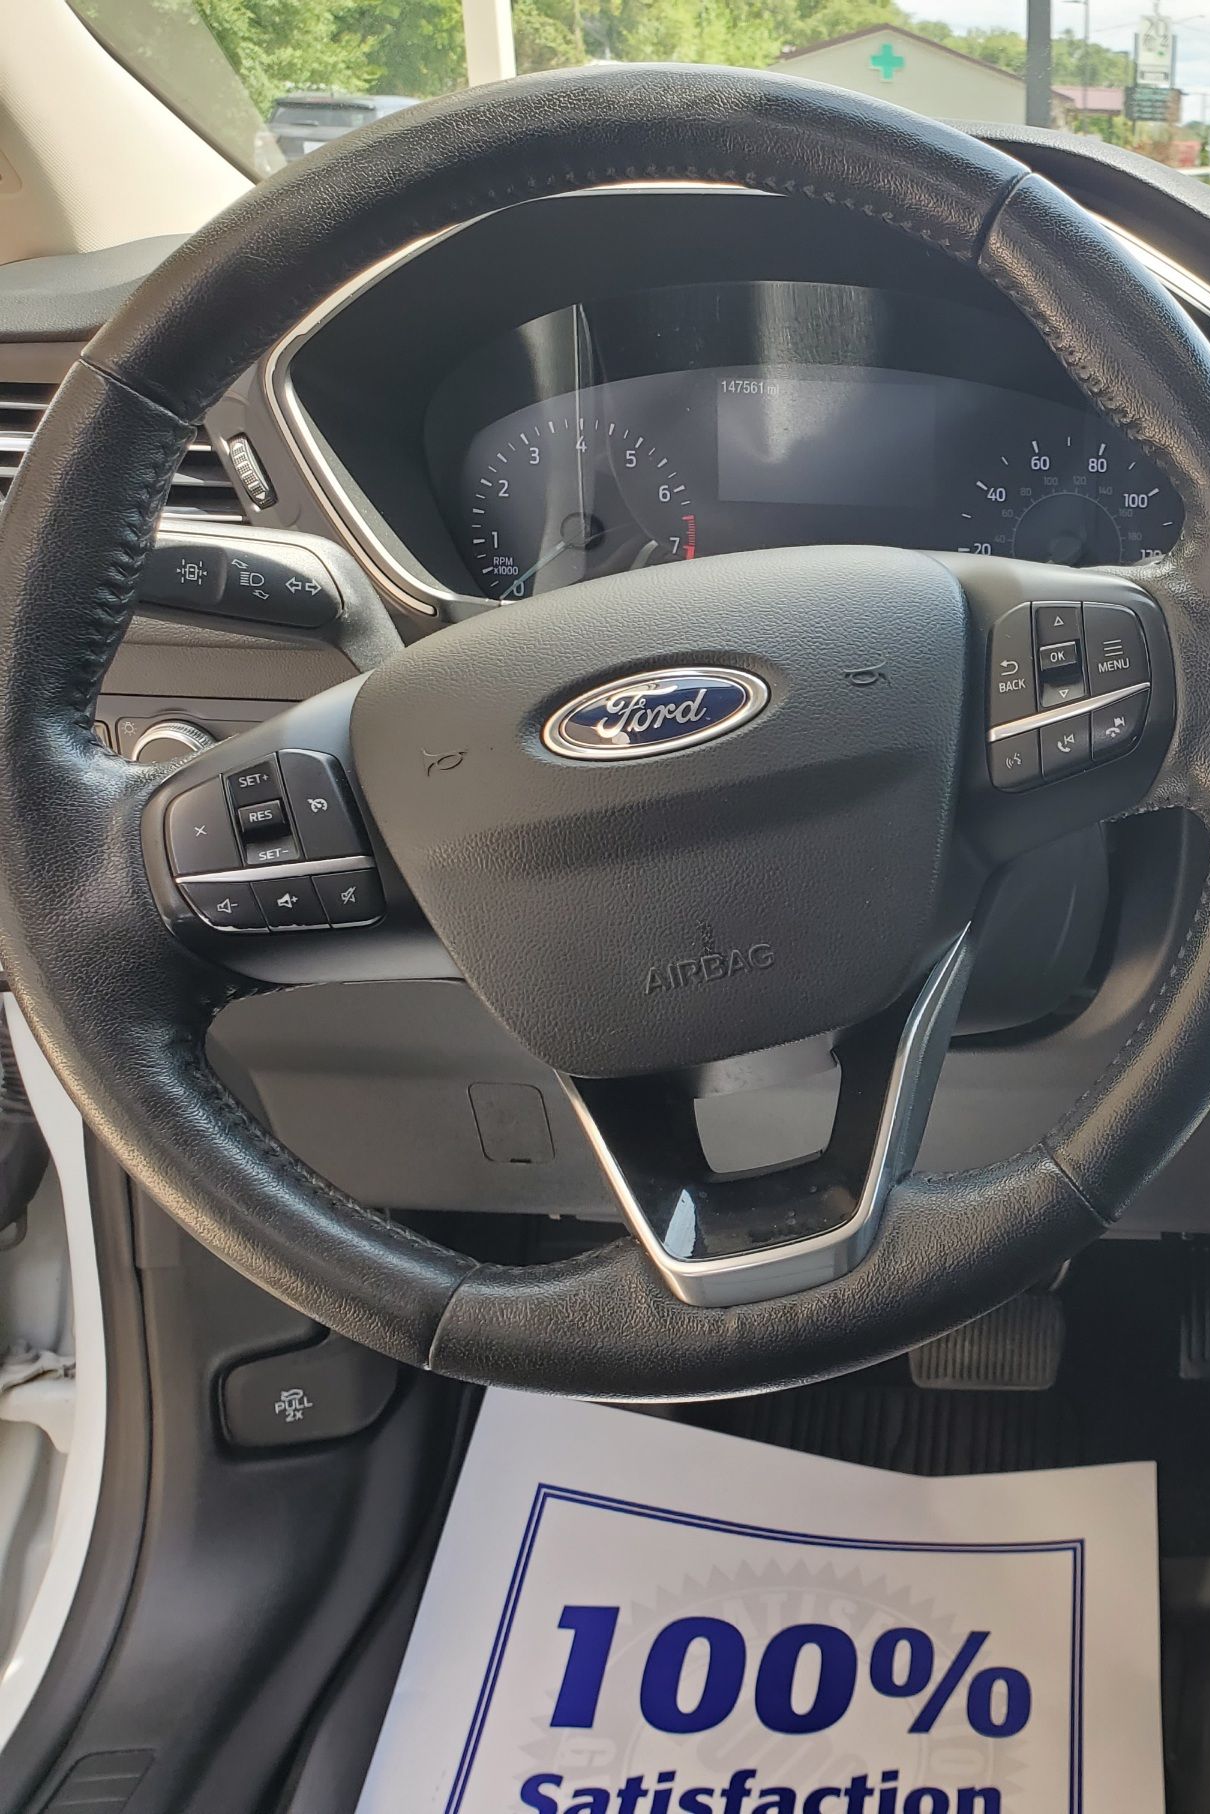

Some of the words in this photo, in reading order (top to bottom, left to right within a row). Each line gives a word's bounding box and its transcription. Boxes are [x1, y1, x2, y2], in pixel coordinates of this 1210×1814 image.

[721, 380, 764, 394] 147561
[575, 438, 587, 453] 4
[529, 448, 540, 465] 3
[626, 450, 637, 468] 5
[1031, 456, 1050, 471] 60
[1088, 458, 1107, 473] 80
[498, 480, 509, 497] 2
[658, 485, 671, 502] 6
[987, 488, 1006, 502] 40
[1123, 494, 1148, 508] 100
[492, 531, 498, 549] 1
[669, 537, 681, 554] 7
[974, 543, 992, 556] 20
[493, 556, 514, 566] RPM
[493, 565, 519, 575] x1000
[513, 580, 525, 597] 0
[1050, 651, 1065, 662] OK
[1098, 657, 1130, 673] MENU
[998, 678, 1026, 693] BACK
[595, 683, 709, 738] Ford
[238, 773, 269, 788] SET+
[249, 809, 273, 822] RES
[643, 943, 776, 995] AIRBAG
[274, 1395, 313, 1415] PULL
[548, 1604, 1033, 1739] 100%
[519, 1769, 1004, 1814] Satisfaction
